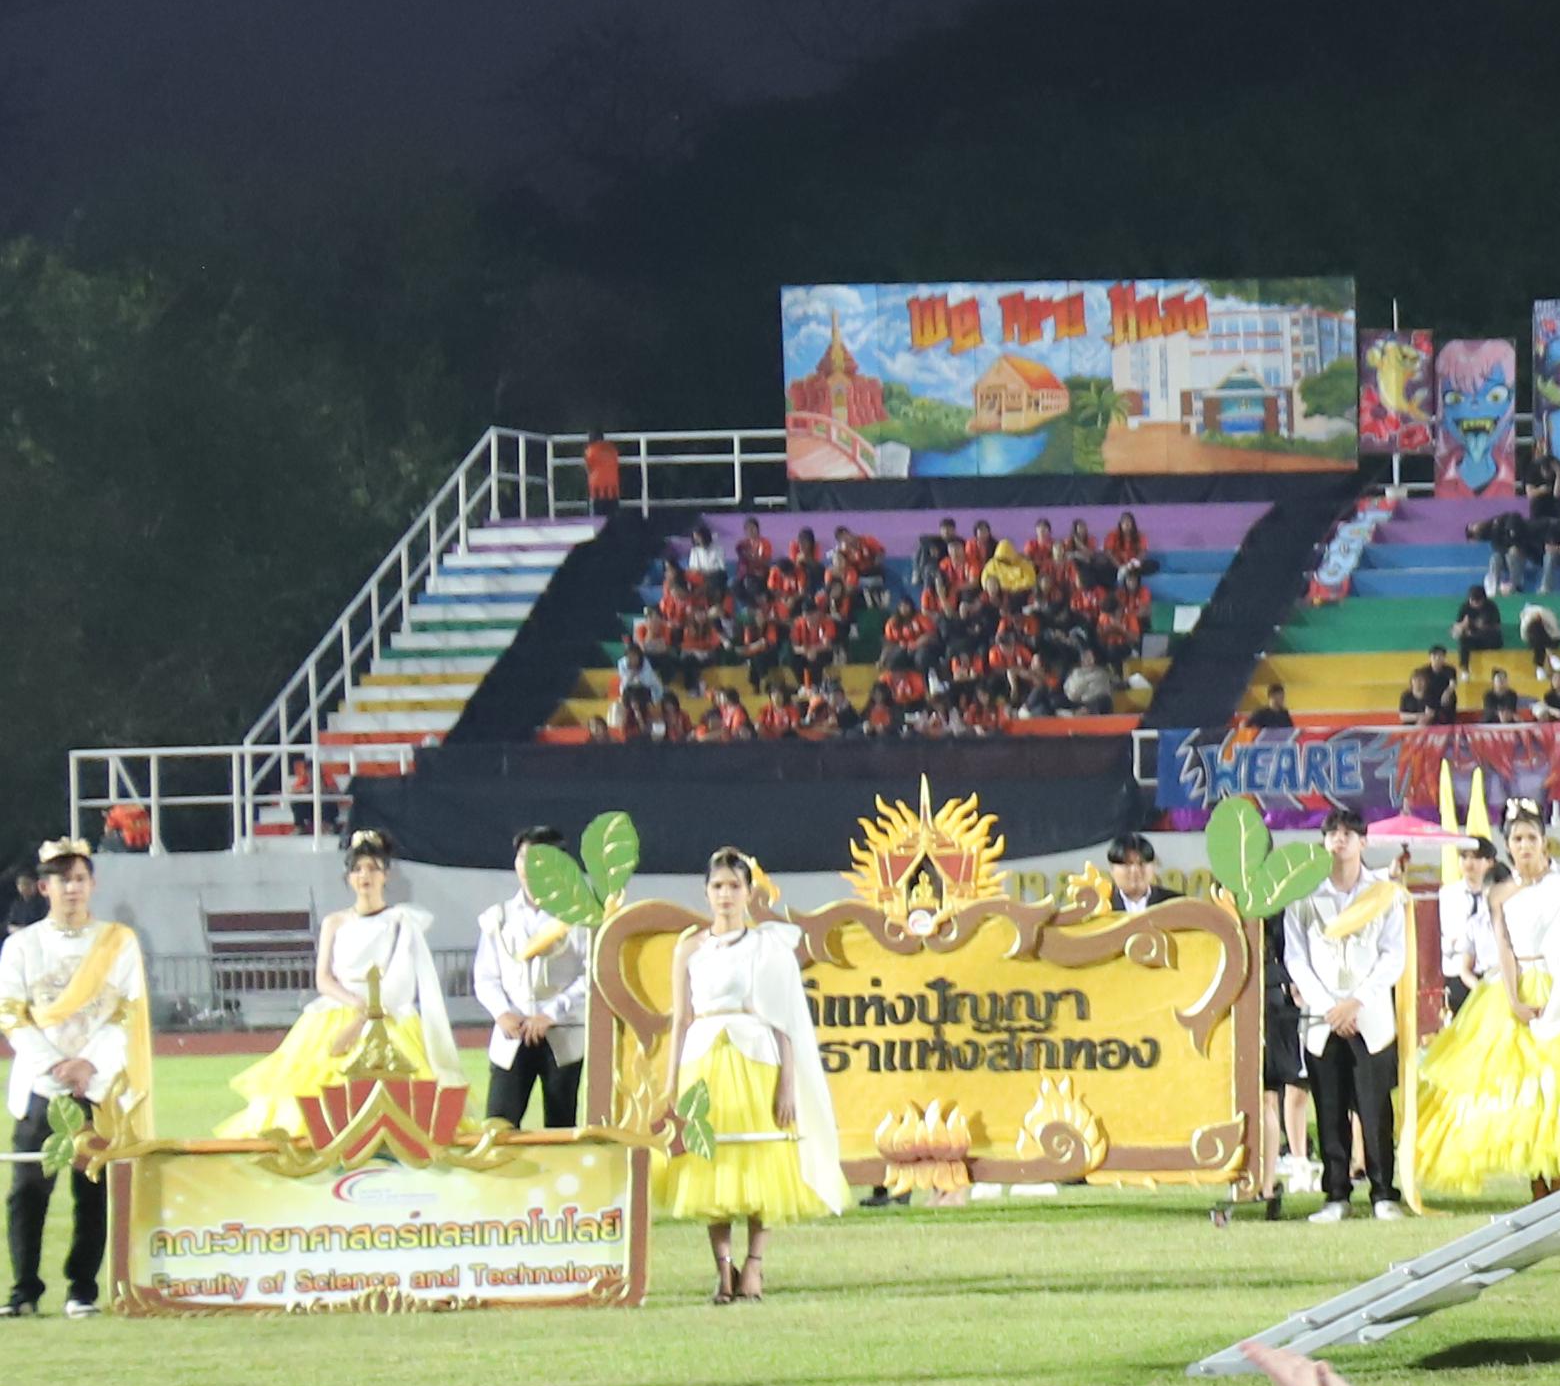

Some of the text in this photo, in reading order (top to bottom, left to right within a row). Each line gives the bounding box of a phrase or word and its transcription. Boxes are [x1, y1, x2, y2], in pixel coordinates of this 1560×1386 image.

[151, 1207, 623, 1257] คณะวิทยาศาสตร์และเทคโนโลยี
[152, 1272, 247, 1301] Faculty
[258, 1271, 285, 1295] of
[295, 1268, 400, 1294] Science
[410, 1265, 460, 1290] and
